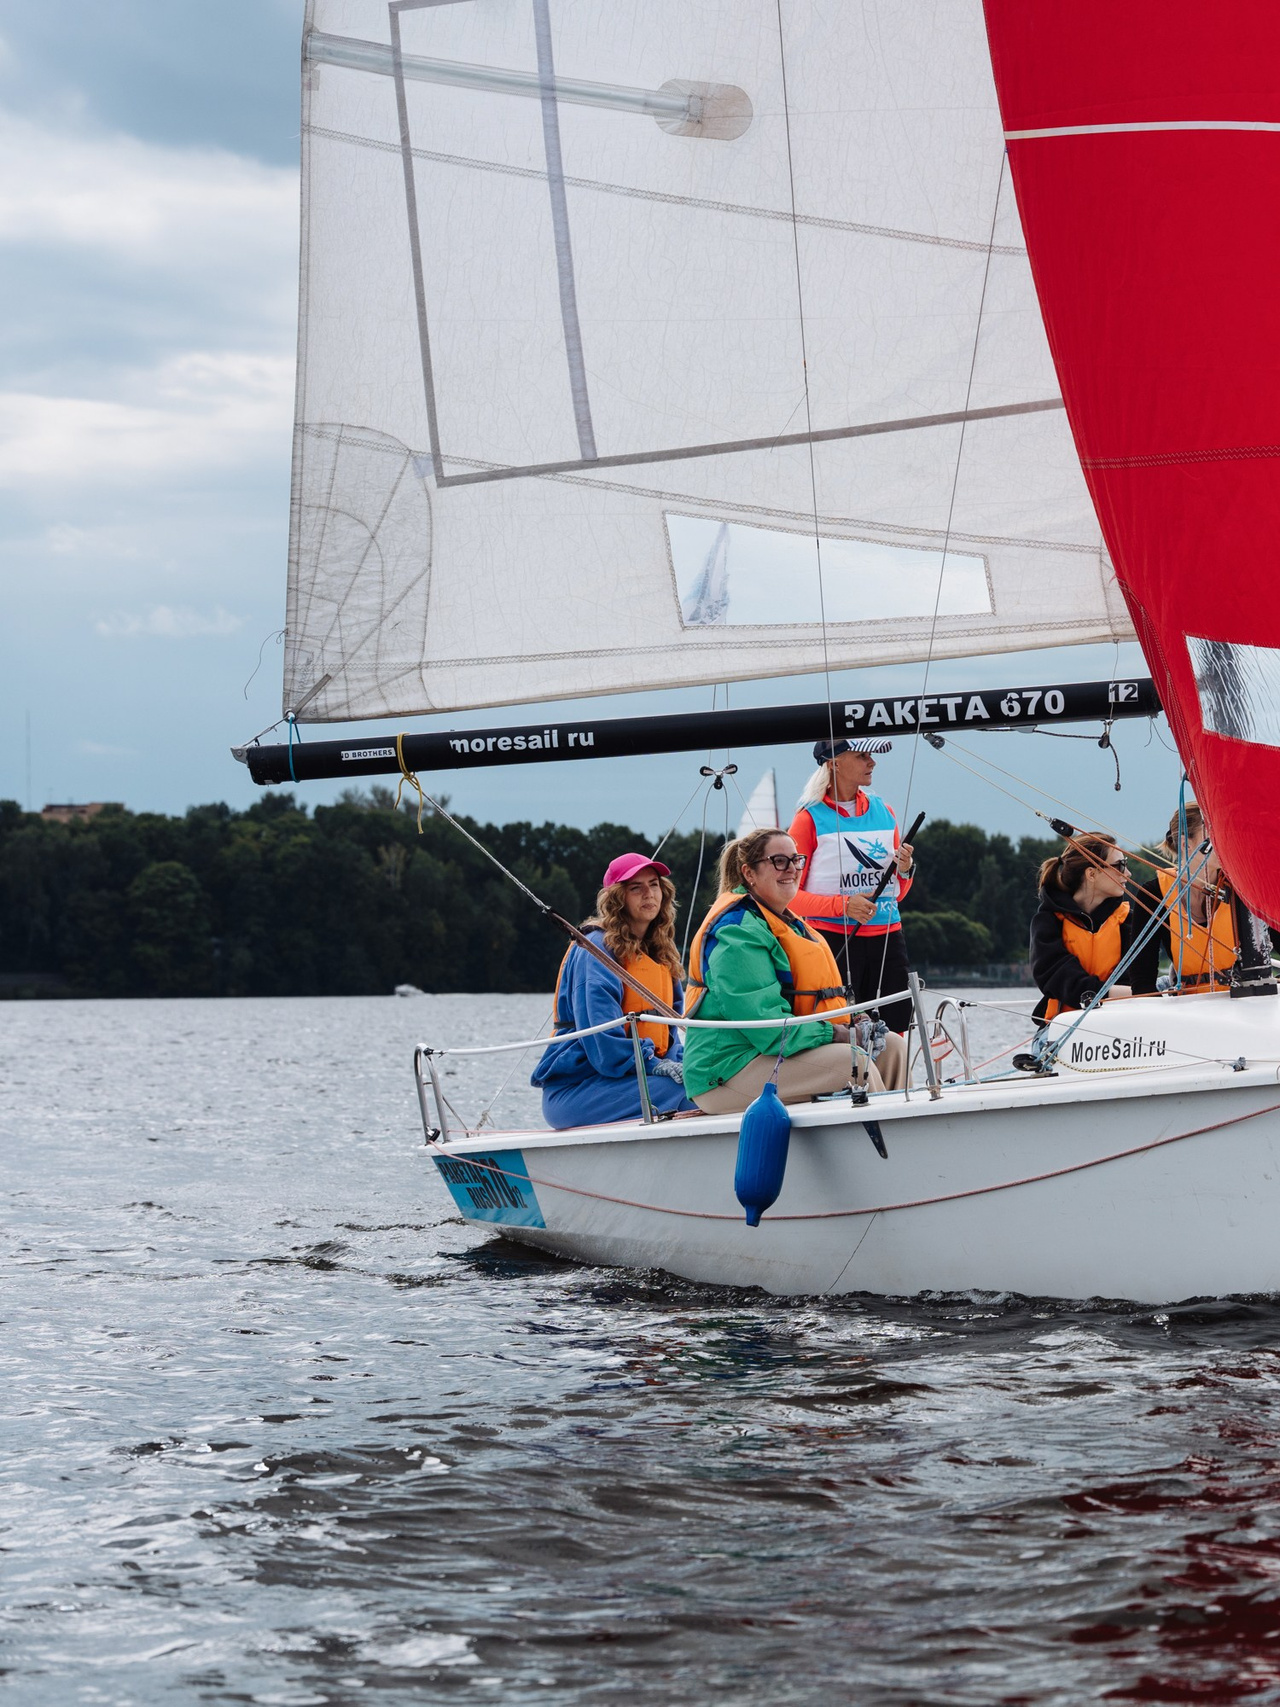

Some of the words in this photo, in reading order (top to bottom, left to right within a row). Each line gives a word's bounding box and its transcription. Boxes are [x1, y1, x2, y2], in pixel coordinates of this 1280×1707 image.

[1000, 690, 1065, 717] 670
[1109, 683, 1138, 702] 12
[450, 730, 558, 754] moresail
[568, 732, 594, 747] ru
[352, 749, 393, 758] BROTHERS
[840, 871, 894, 888] MORESL
[1071, 1037, 1166, 1063] MoreSail.ru
[466, 1187, 494, 1209] RUS
